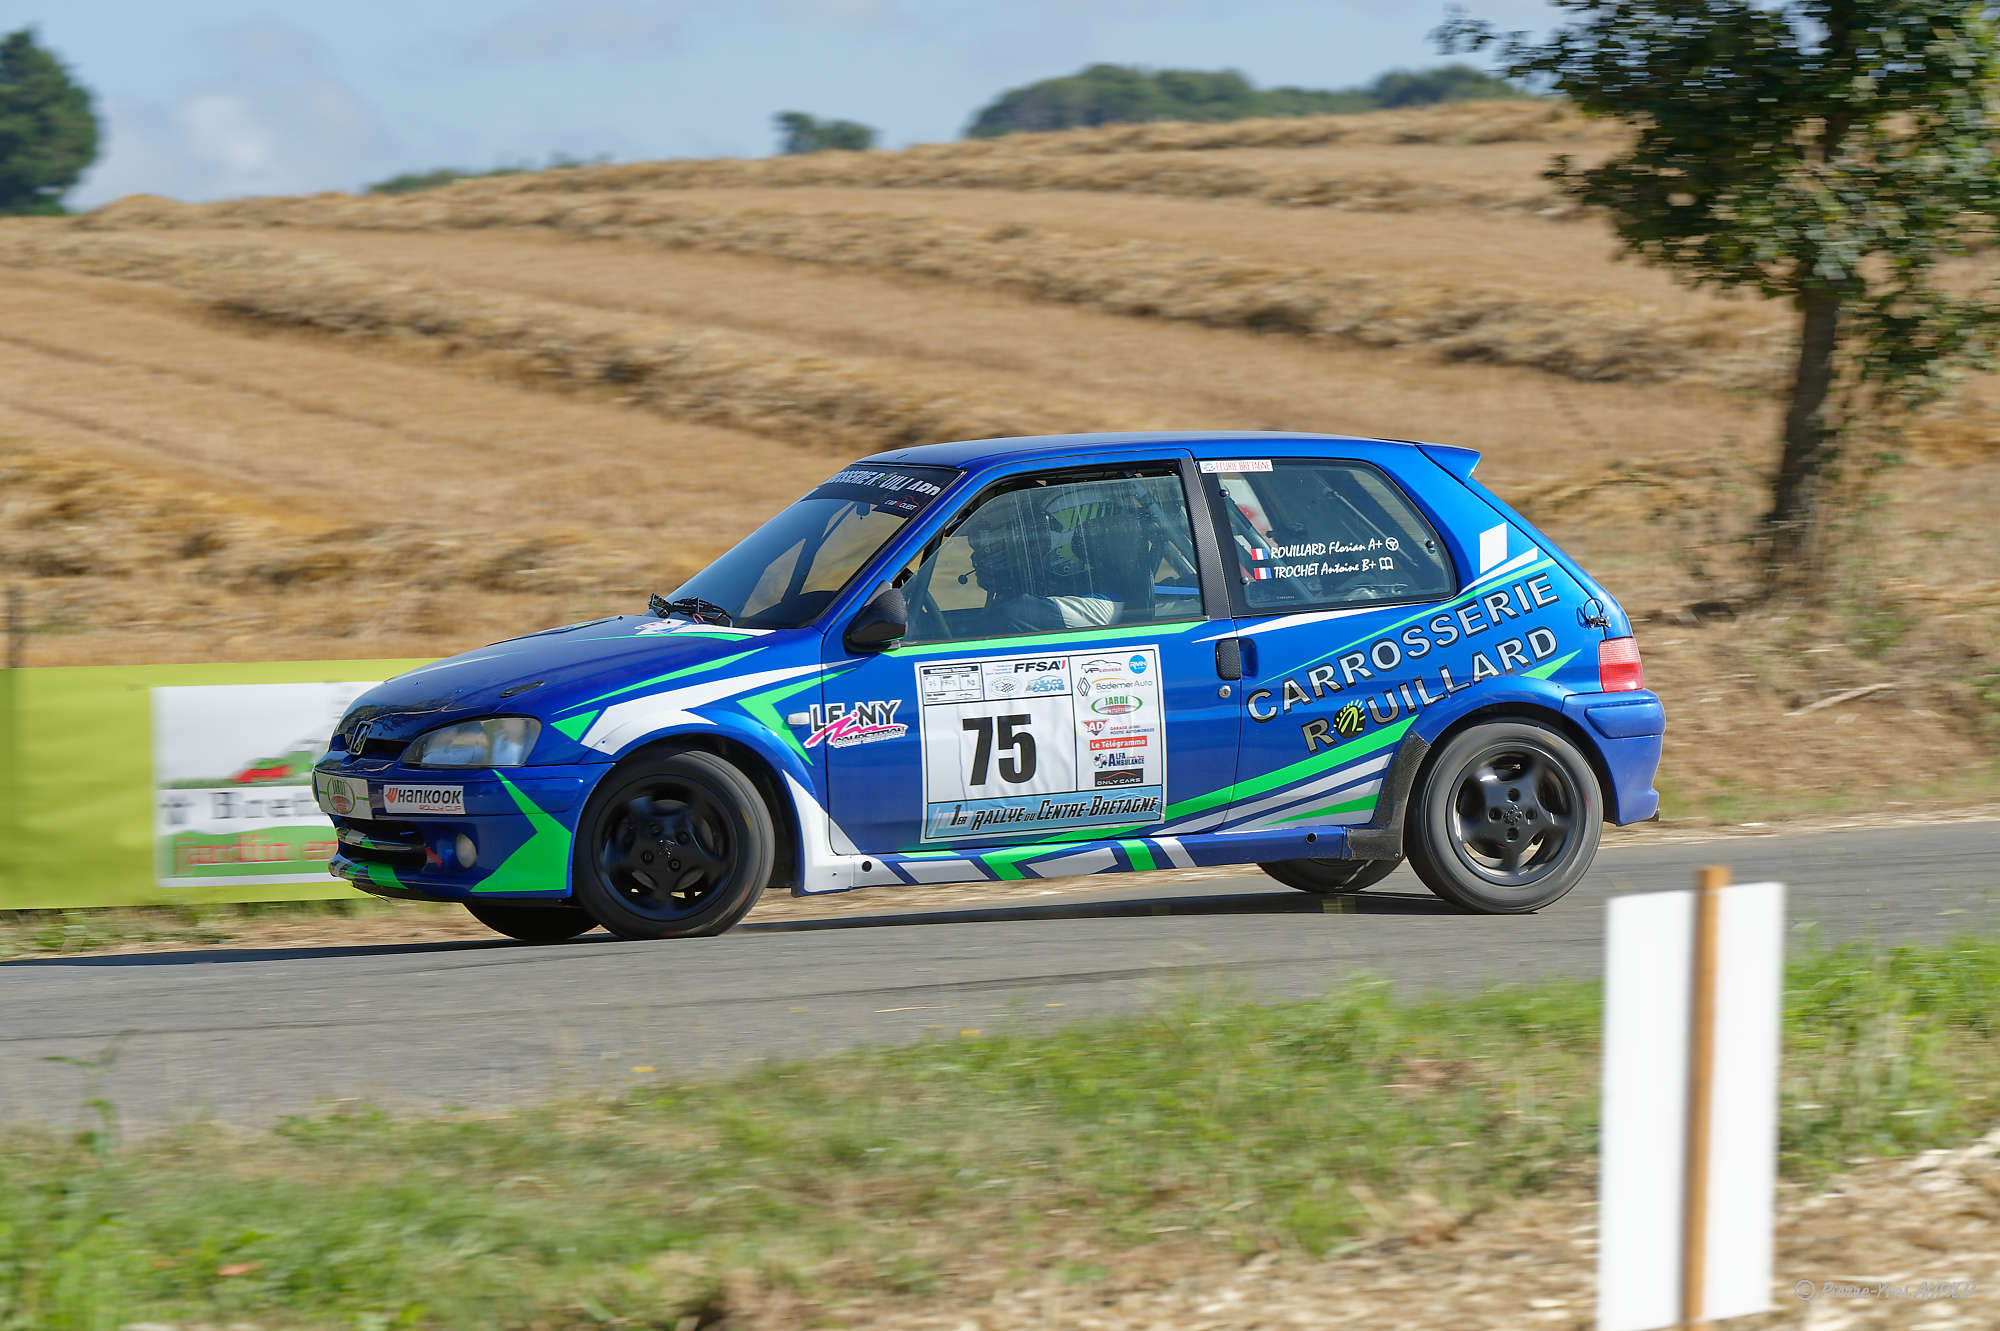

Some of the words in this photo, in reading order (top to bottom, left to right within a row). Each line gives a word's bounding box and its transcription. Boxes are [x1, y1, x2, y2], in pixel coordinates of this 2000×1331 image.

[1271, 542, 1326, 559] ROUILLARD
[1329, 541, 1366, 553] Florian
[1368, 538, 1383, 551] A+
[1274, 562, 1320, 579] TROCHET
[1320, 562, 1359, 576] Antoine
[1362, 559, 1376, 572] B+
[1246, 572, 1560, 723] CARROSSERIE
[1013, 660, 1062, 674] FFSA
[1105, 695, 1128, 705] JARDI
[855, 700, 902, 727] NY
[1088, 721, 1105, 732] AD
[962, 713, 1037, 786] 75
[1091, 742, 1100, 750] Le
[1102, 739, 1146, 750] Télégramme
[970, 807, 1025, 831] RALLYE
[1036, 795, 1159, 821] CENTRE-BRETAGNE
